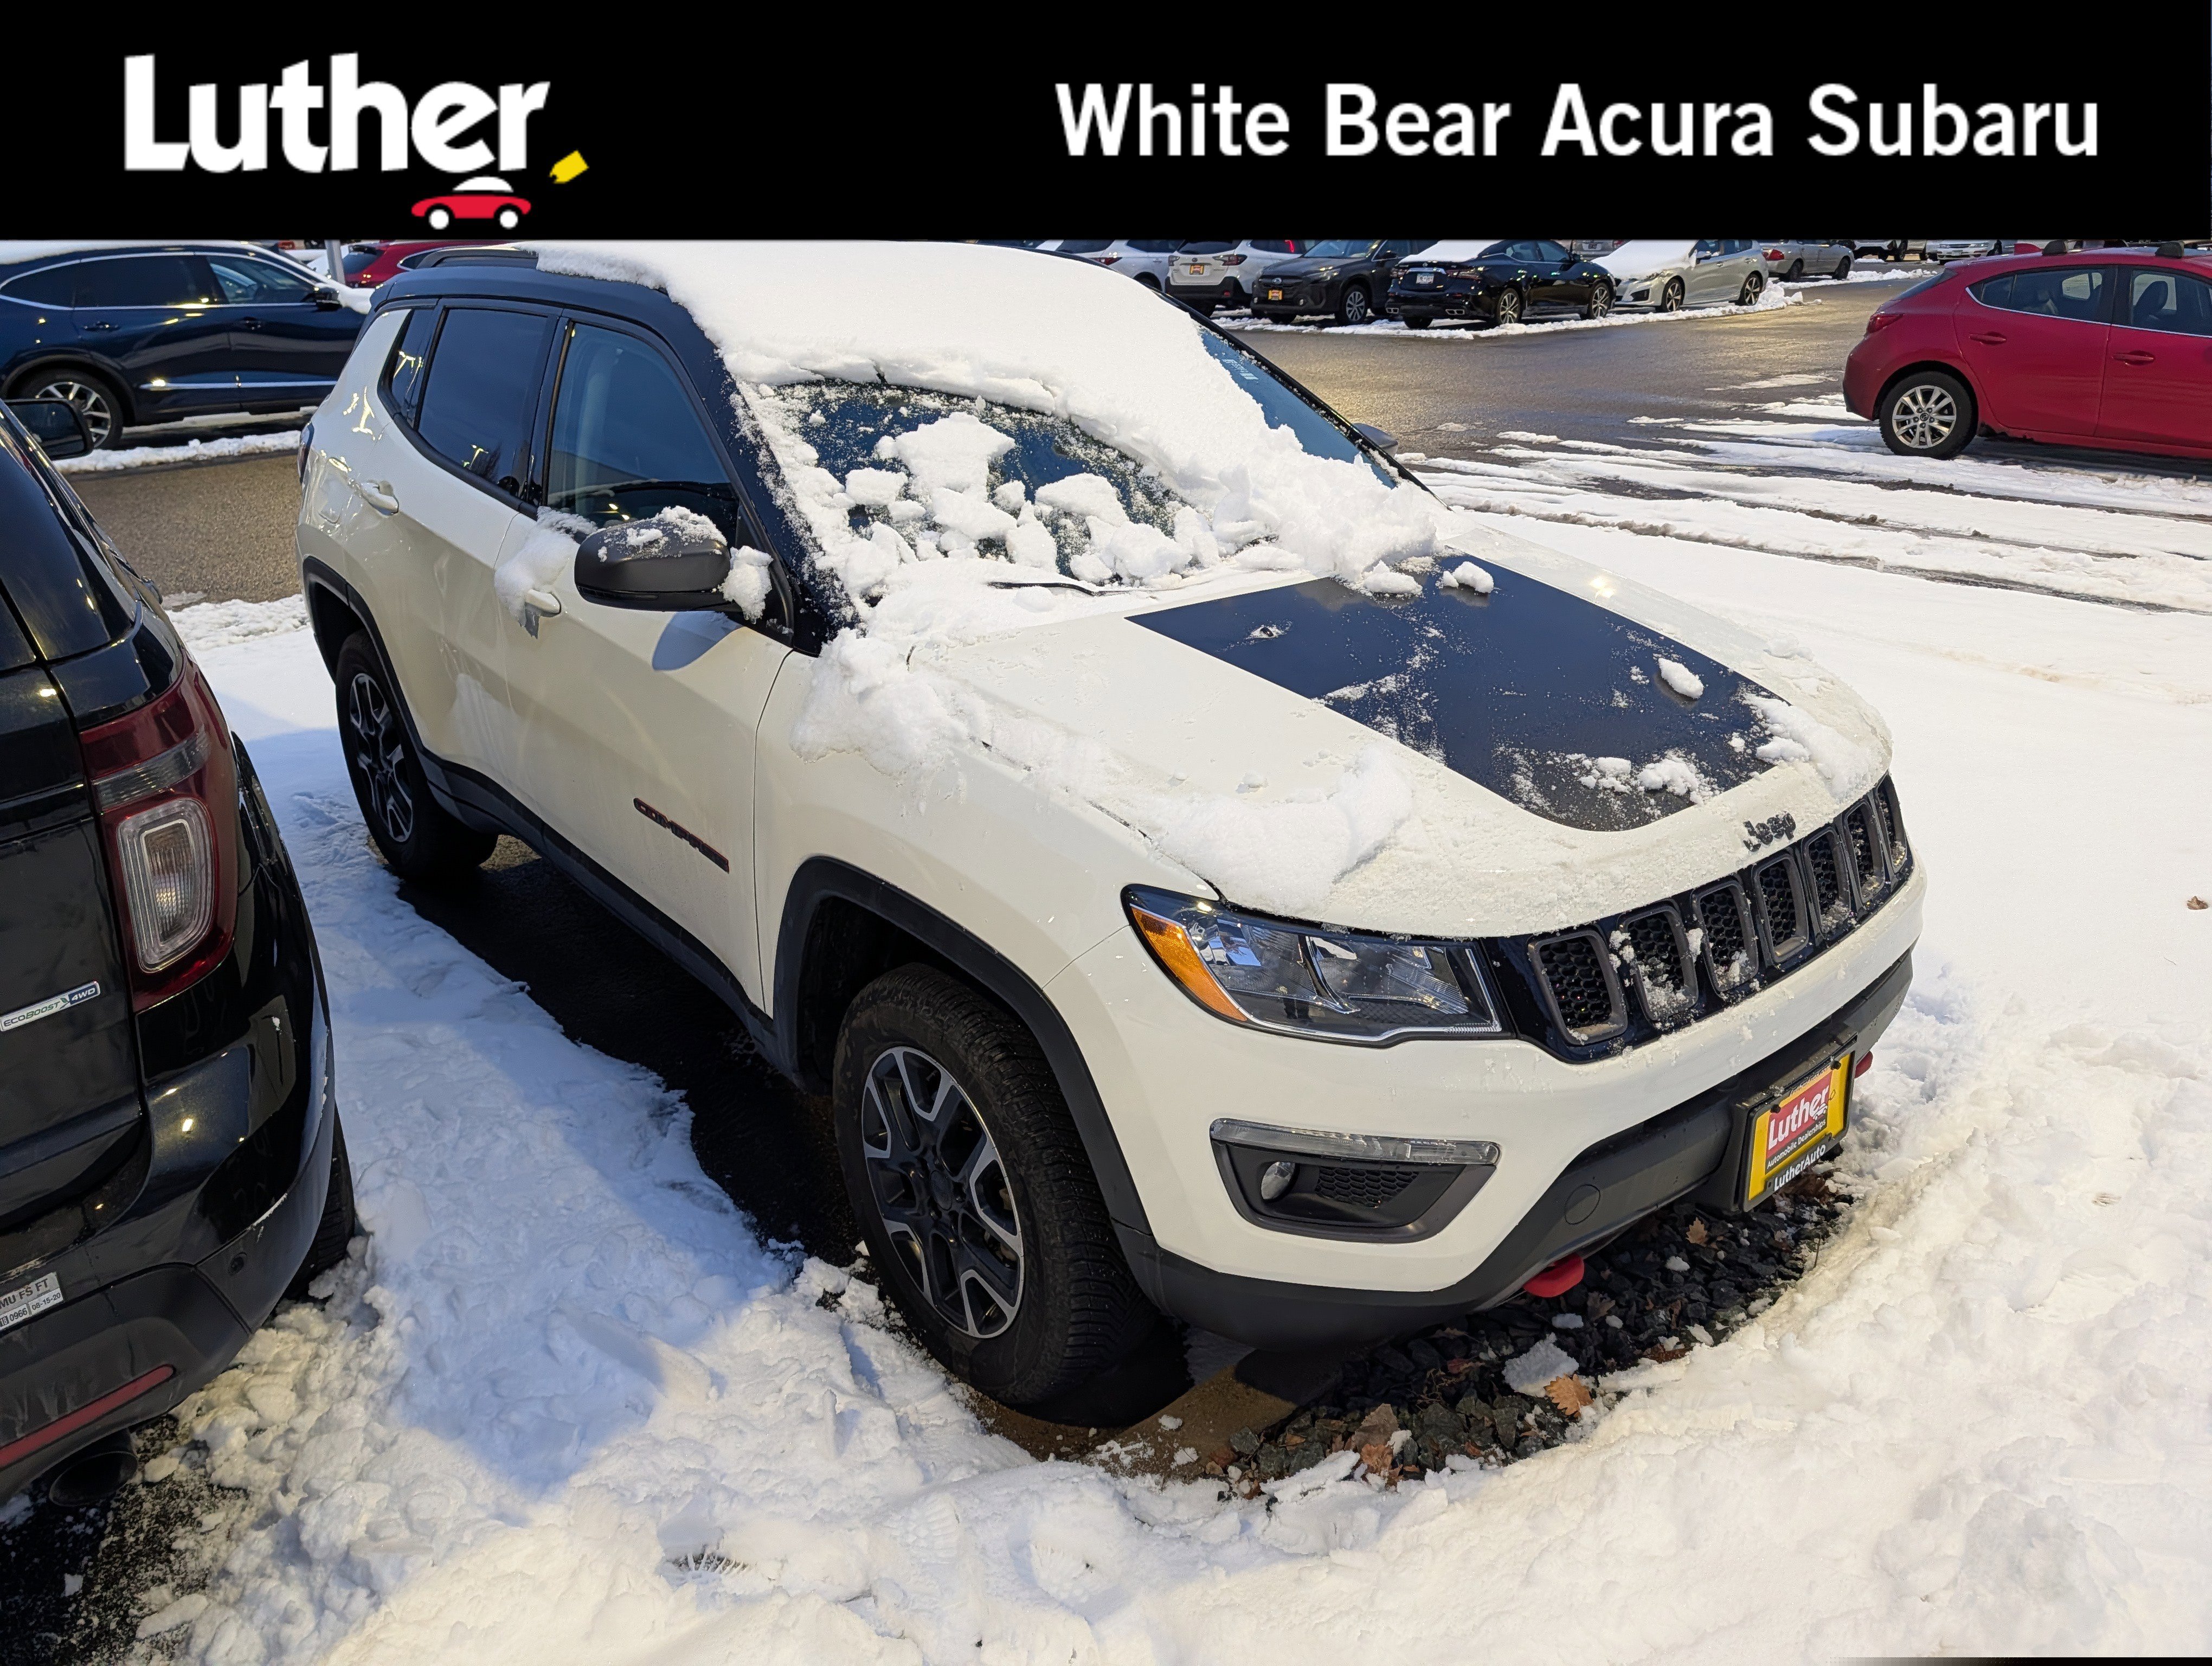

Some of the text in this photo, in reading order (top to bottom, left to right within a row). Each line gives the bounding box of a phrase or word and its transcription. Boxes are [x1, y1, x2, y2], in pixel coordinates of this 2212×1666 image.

[1742, 811, 1796, 852] Jeep
[71, 987, 96, 1002] 4WD
[1768, 1085, 1829, 1151] Luther
[1767, 1119, 1826, 1169] Automobile Dealerships
[1774, 1144, 1826, 1191] LutherAuto
[18, 1286, 33, 1300] FS
[35, 1278, 48, 1292] FT
[31, 1292, 61, 1310] 08-15-20
[9, 1308, 28, 1322] 0966
